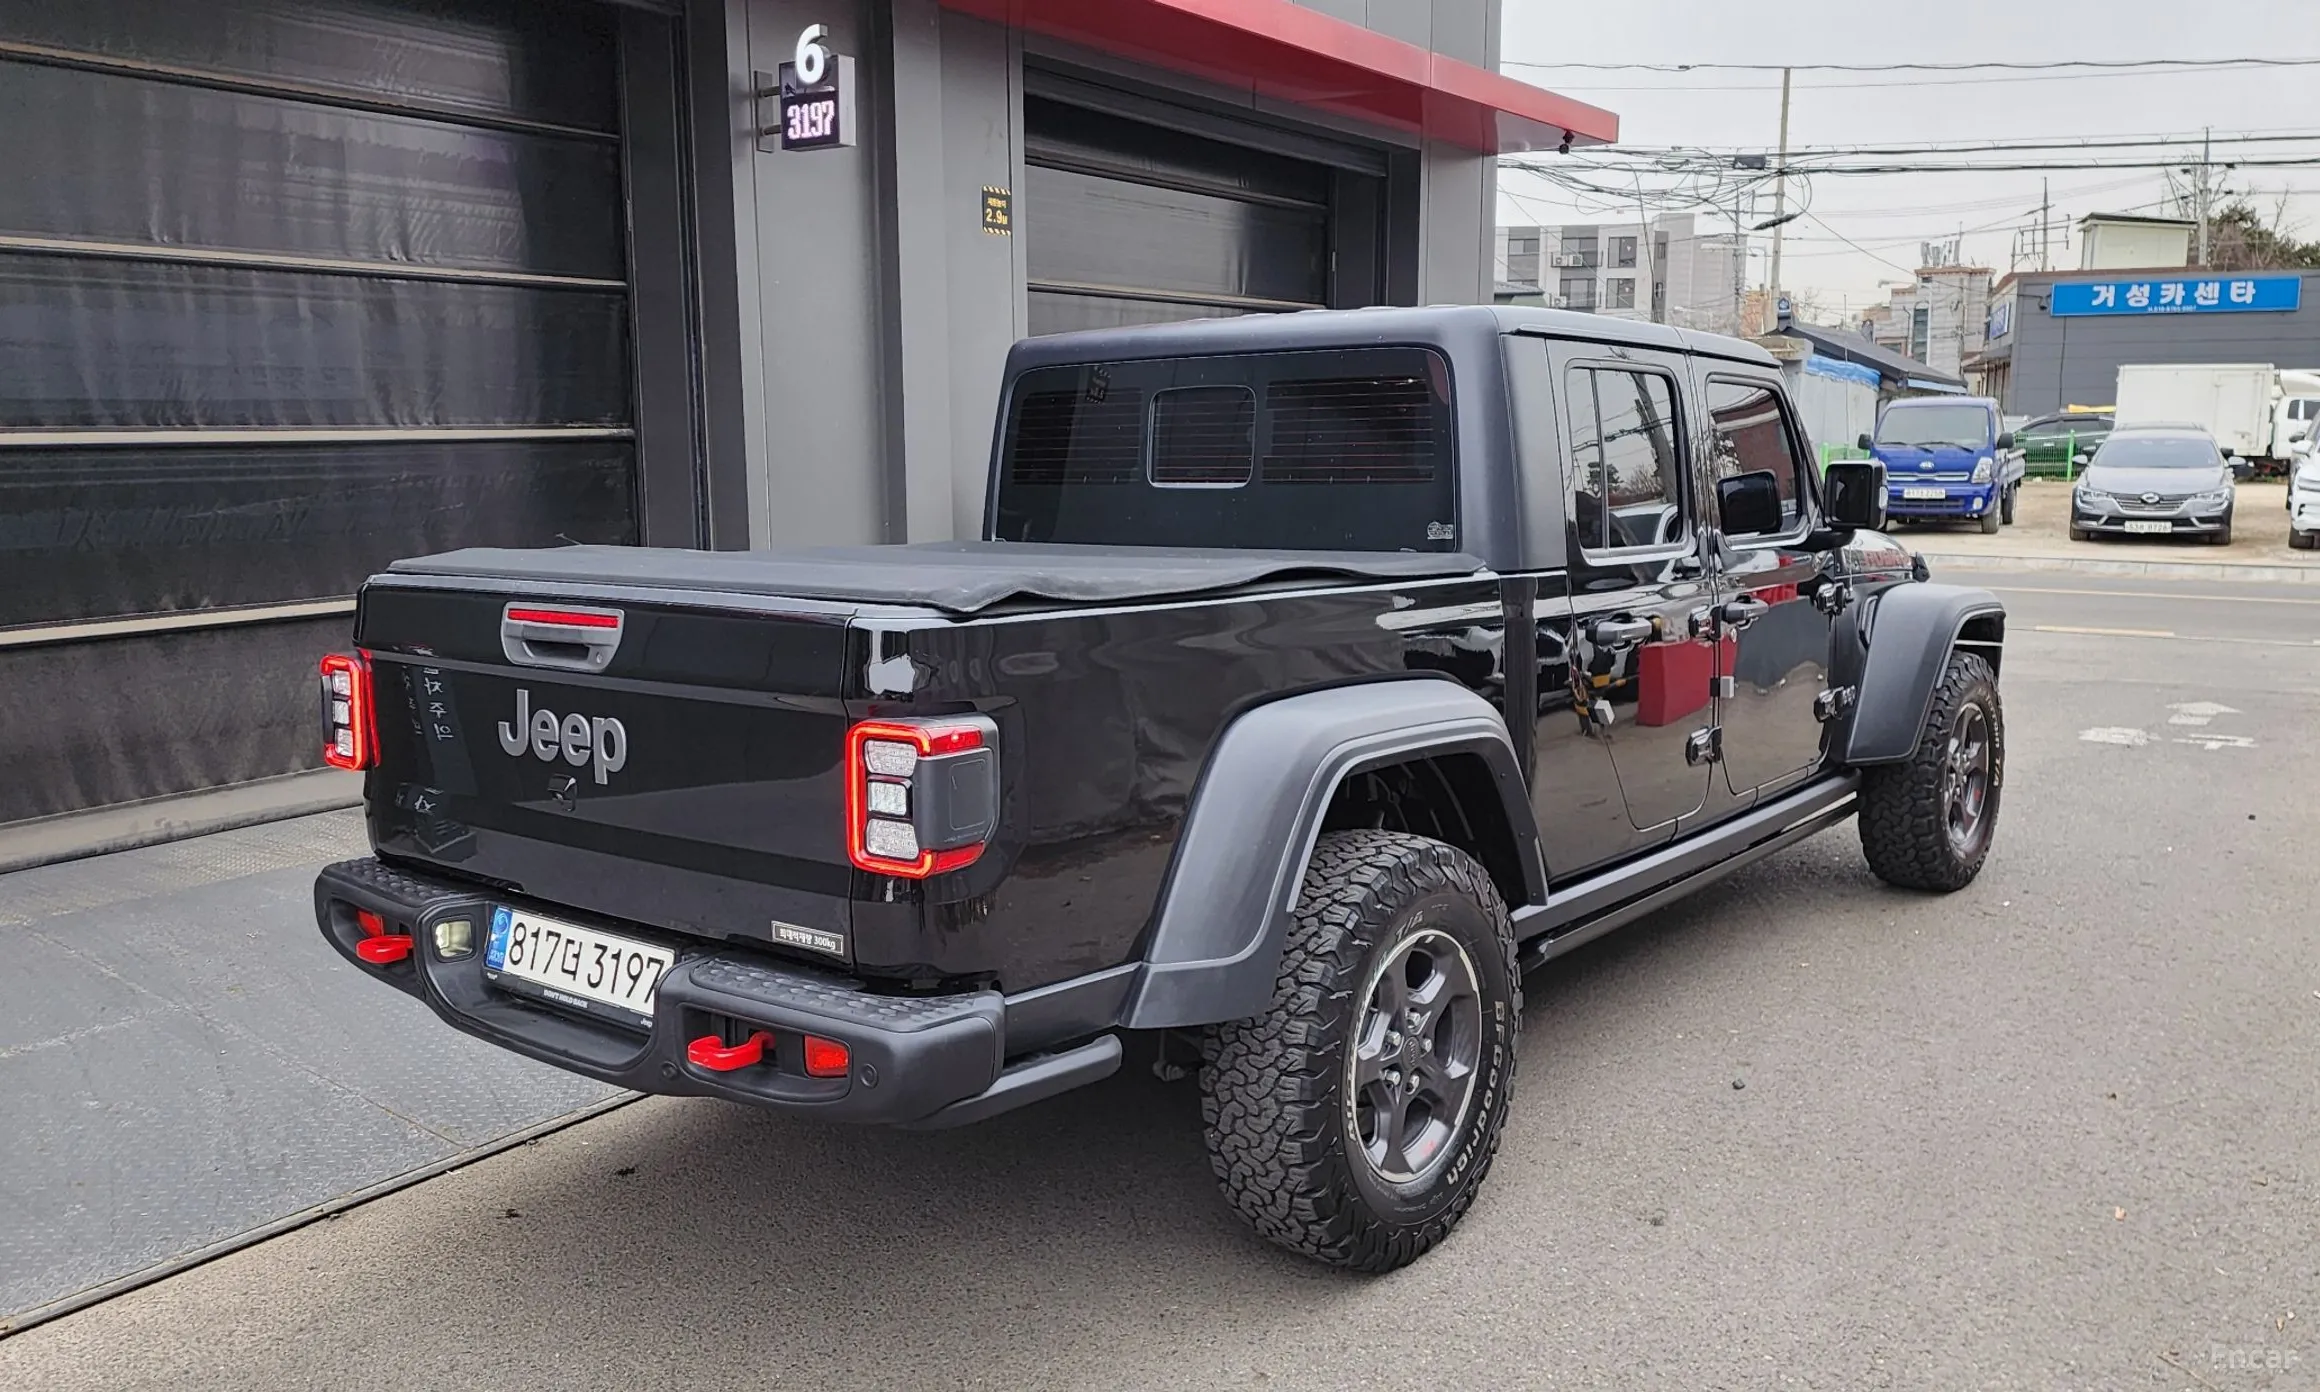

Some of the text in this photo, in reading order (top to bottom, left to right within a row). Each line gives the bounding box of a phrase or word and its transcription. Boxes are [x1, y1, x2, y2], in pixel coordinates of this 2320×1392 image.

[796, 23, 827, 85] 6
[787, 100, 835, 140] 3197
[2091, 281, 2256, 307] 거성카센타
[498, 688, 627, 785] Jeep
[509, 922, 665, 1004] 817더 3197
[814, 935, 836, 950] 300kg
